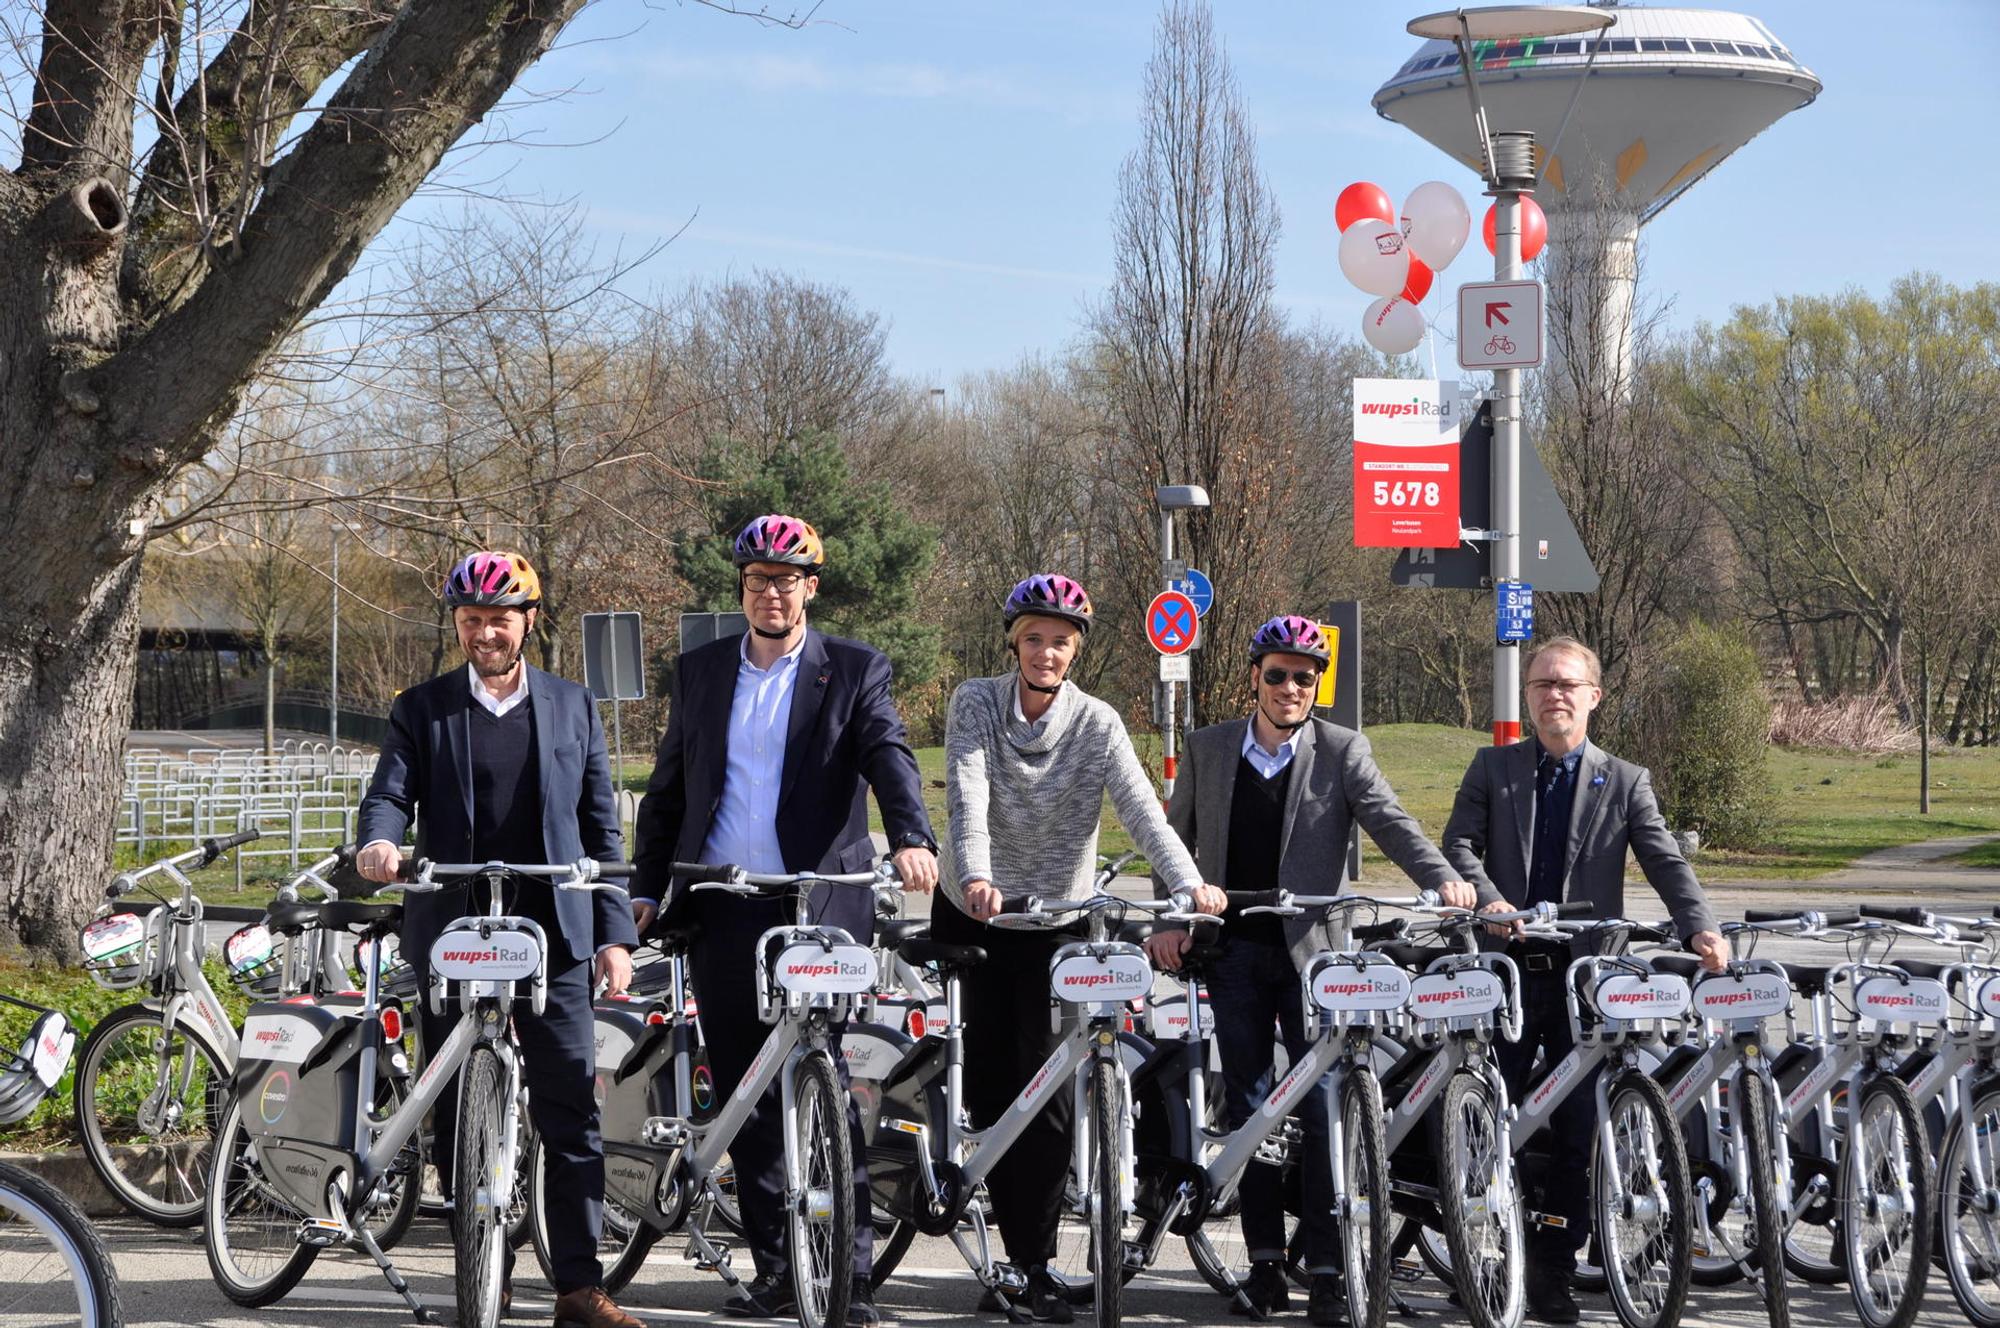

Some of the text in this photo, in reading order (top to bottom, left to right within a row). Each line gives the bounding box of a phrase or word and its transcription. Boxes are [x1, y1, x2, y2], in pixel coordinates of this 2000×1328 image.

[1374, 481, 1440, 506] 5678
[443, 946, 528, 965] wupsiRad
[787, 960, 867, 977] wupsiRad
[1063, 969, 1141, 987] wupsiRad
[1324, 979, 1400, 996] wupsiRad
[1417, 985, 1492, 1004] wupsiRad
[1608, 988, 1681, 1005] wupsiRad
[1704, 987, 1780, 1006] wupsiRad
[1867, 993, 1940, 1008] wupsiRad
